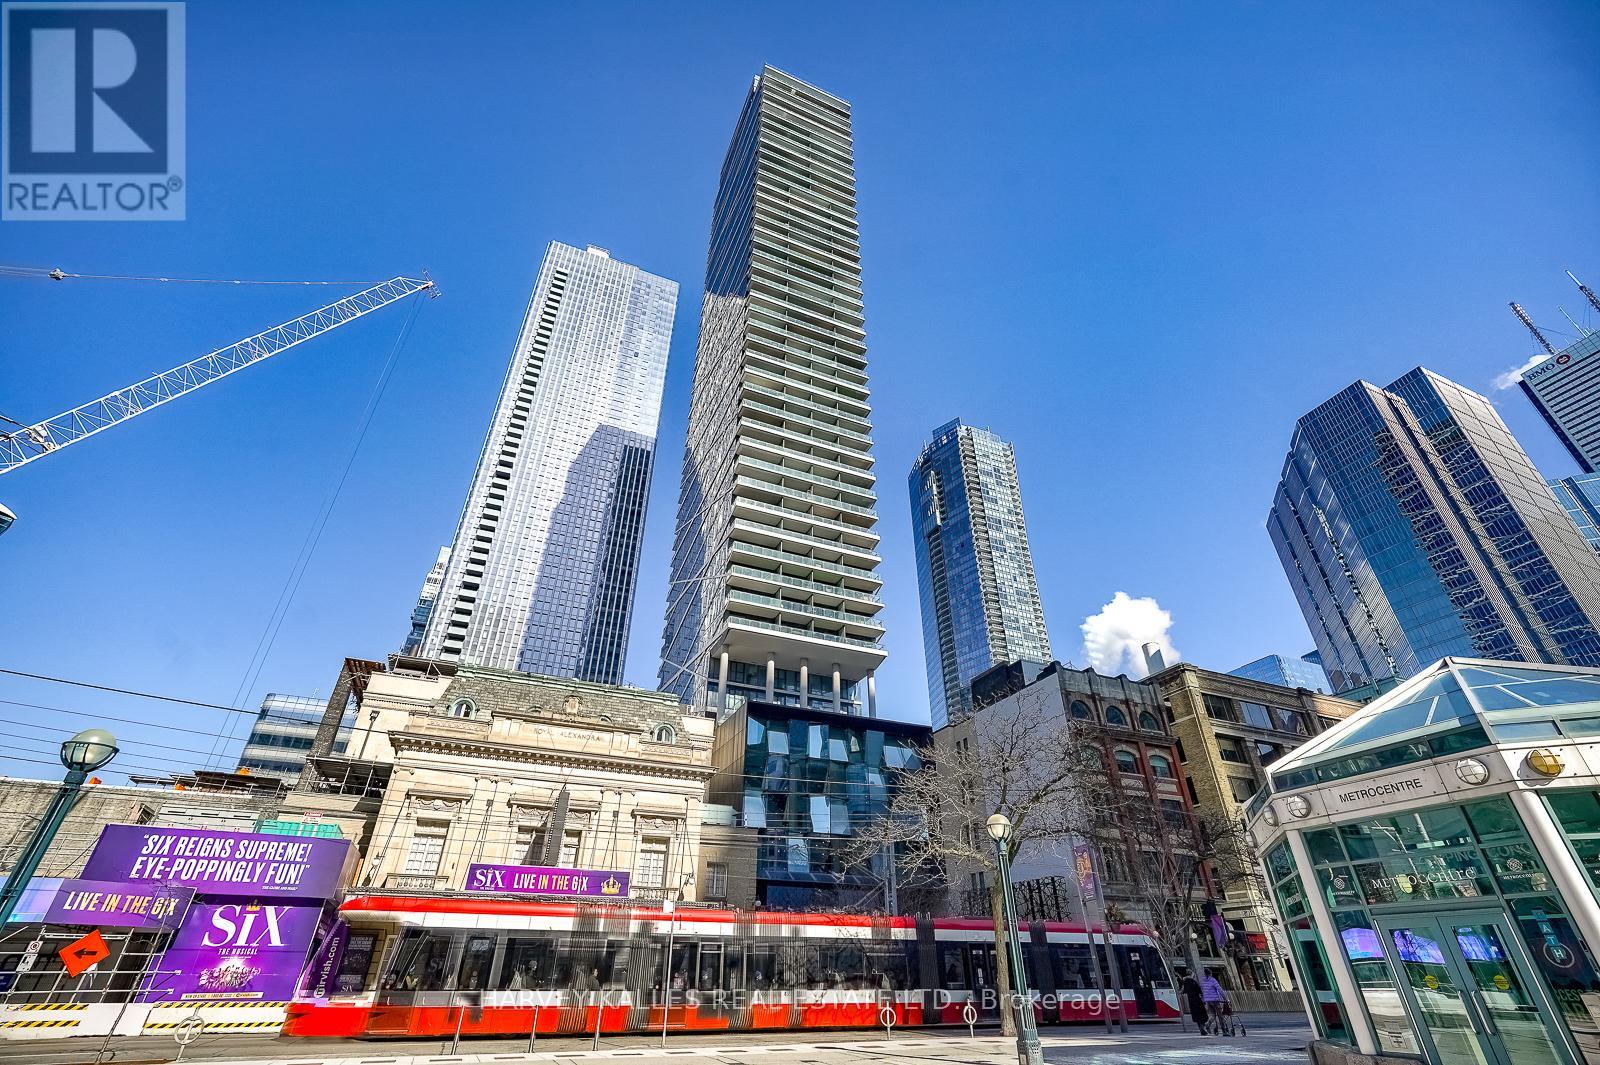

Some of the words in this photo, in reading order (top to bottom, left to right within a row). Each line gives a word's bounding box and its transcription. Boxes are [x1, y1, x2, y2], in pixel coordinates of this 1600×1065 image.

[1527, 363, 1556, 381] BMO
[1339, 779, 1423, 803] METROCENTRE
[175, 836, 235, 860] REIGNS
[235, 838, 313, 863] SUPREME!
[128, 856, 266, 884] EYE-POPPINGLY
[513, 873, 536, 889] LIVE
[537, 874, 549, 890] IN
[550, 875, 571, 891] THE
[63, 891, 104, 911] LIVE
[100, 893, 122, 913] IN
[121, 895, 153, 914] THE
